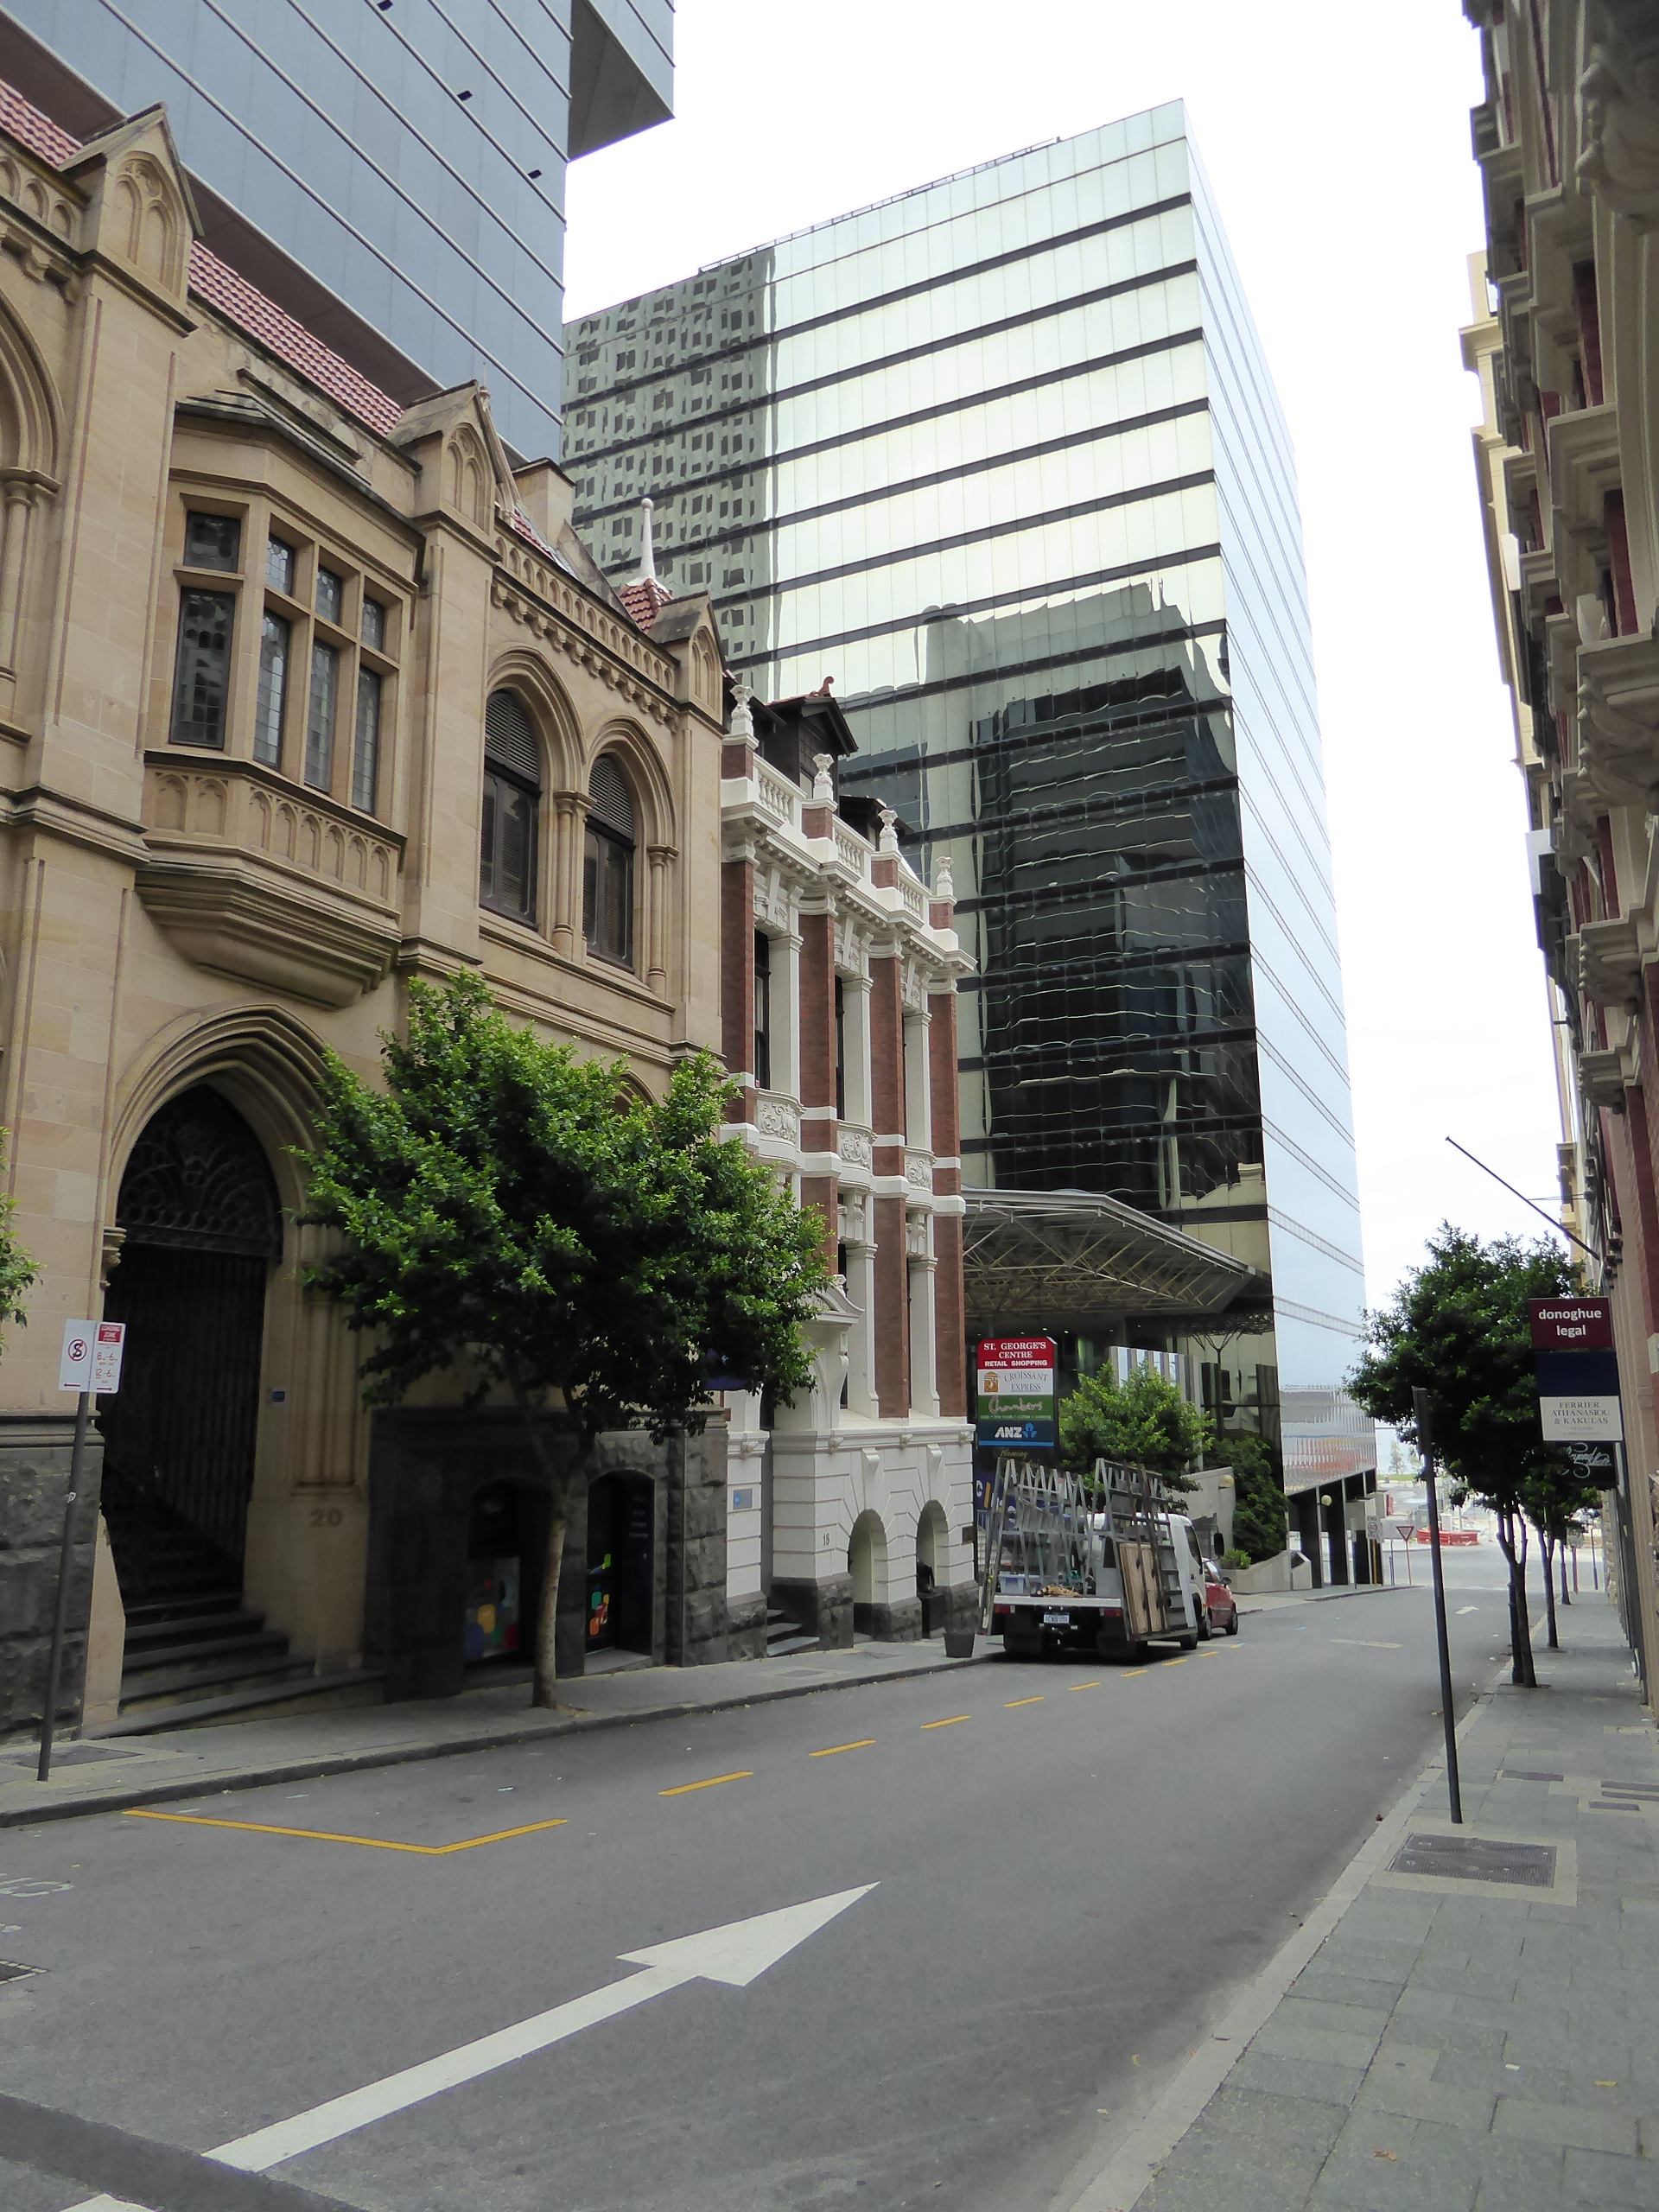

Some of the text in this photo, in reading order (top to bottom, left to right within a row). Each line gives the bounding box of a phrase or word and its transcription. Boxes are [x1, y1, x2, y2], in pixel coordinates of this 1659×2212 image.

[1538, 1308, 1602, 1321] donoghue
[1556, 1325, 1586, 1338] legal
[1004, 1371, 1048, 1382] CROISSANT
[1011, 1383, 1041, 1392] EXPRESS
[988, 1395, 1043, 1414] Chambers
[995, 1426, 1022, 1439] ANZ
[309, 1508, 343, 1528] 20
[823, 1532, 830, 1546] 18
